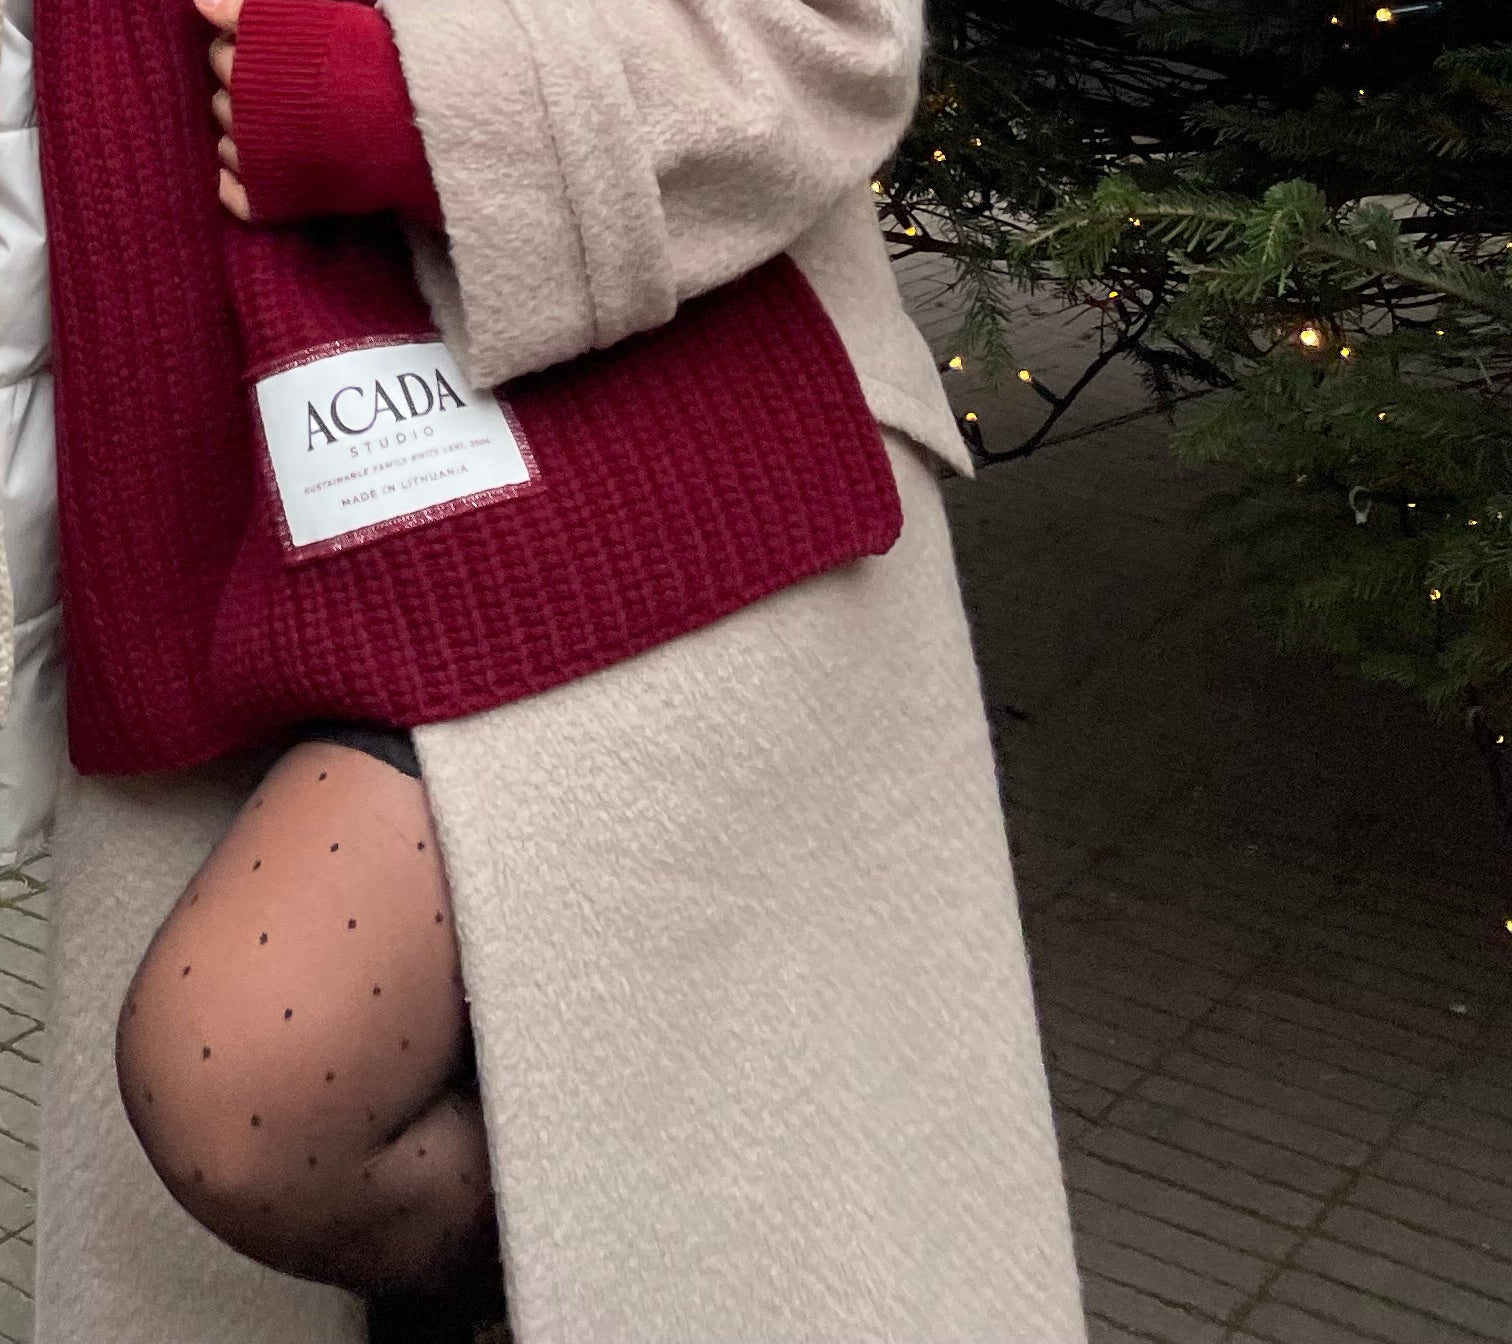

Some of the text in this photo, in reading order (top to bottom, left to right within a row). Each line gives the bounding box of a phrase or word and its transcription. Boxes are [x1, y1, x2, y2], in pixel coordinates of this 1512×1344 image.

[306, 367, 467, 452] ACADA
[349, 425, 435, 459] STUDIO
[340, 488, 379, 508] MADE
